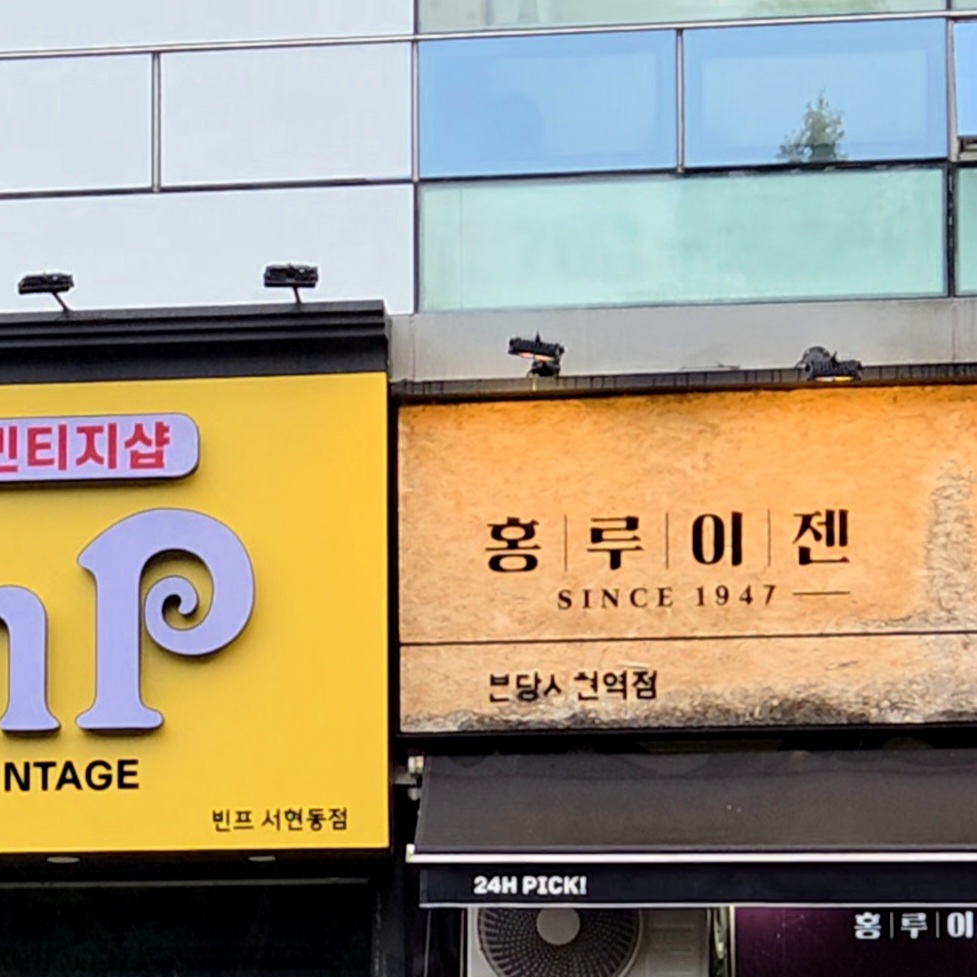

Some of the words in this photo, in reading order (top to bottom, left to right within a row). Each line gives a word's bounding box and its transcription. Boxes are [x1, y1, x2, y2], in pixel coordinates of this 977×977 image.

[557, 586, 674, 611] SINCE
[695, 584, 777, 608] 1947
[212, 808, 255, 833] 빈프
[261, 806, 348, 832] 서현동점
[473, 875, 518, 895] 24H
[521, 875, 588, 895] PICK!
